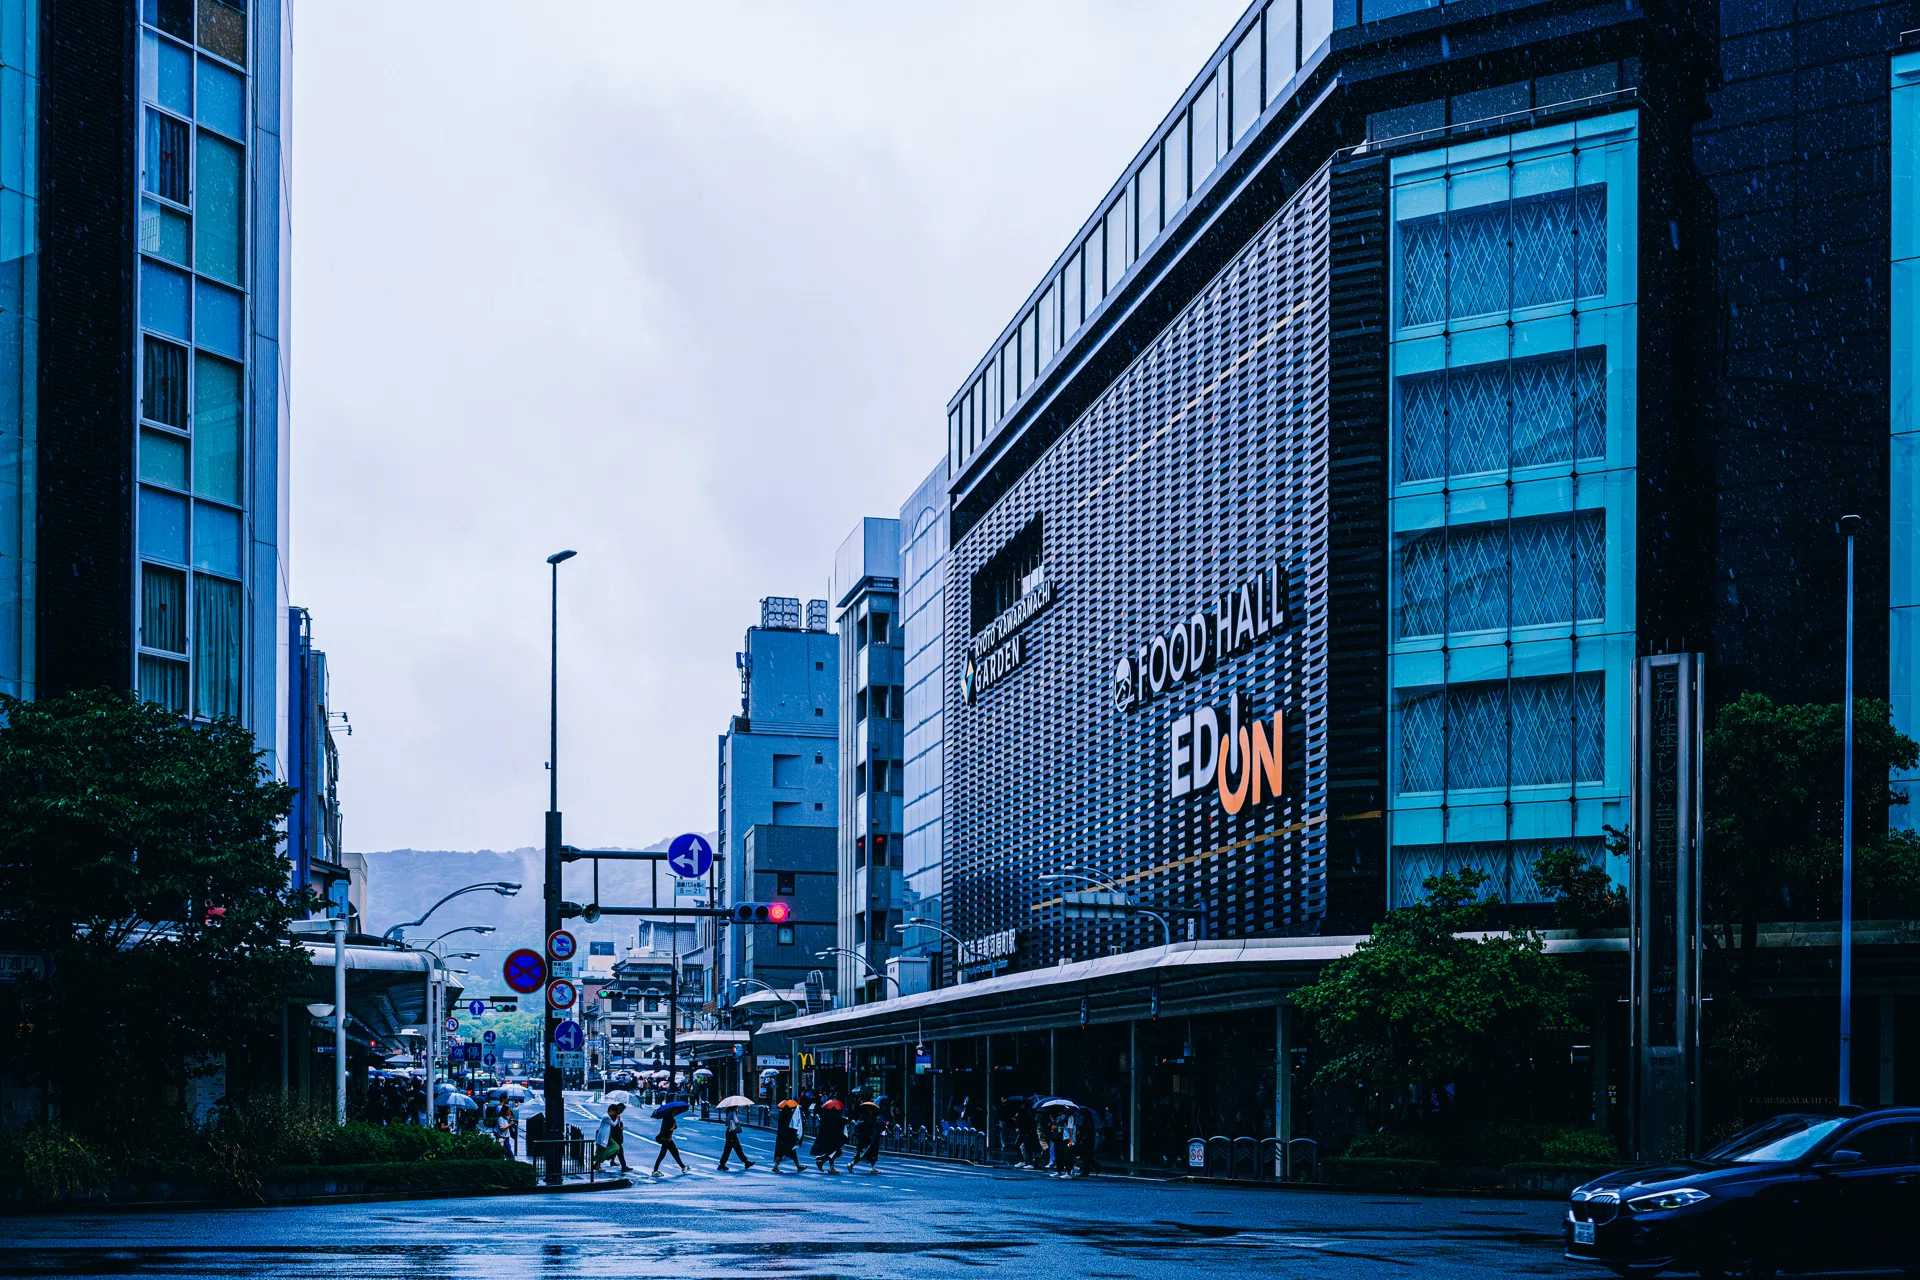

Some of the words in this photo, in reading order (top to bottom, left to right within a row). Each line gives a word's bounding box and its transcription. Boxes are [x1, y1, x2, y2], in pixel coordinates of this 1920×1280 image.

[975, 627, 997, 659] KYOTO
[997, 581, 1052, 639] KAWARAMACHI
[1138, 612, 1209, 702] FOOD
[1214, 563, 1286, 655] HALL
[974, 636, 1021, 693] GARDEN
